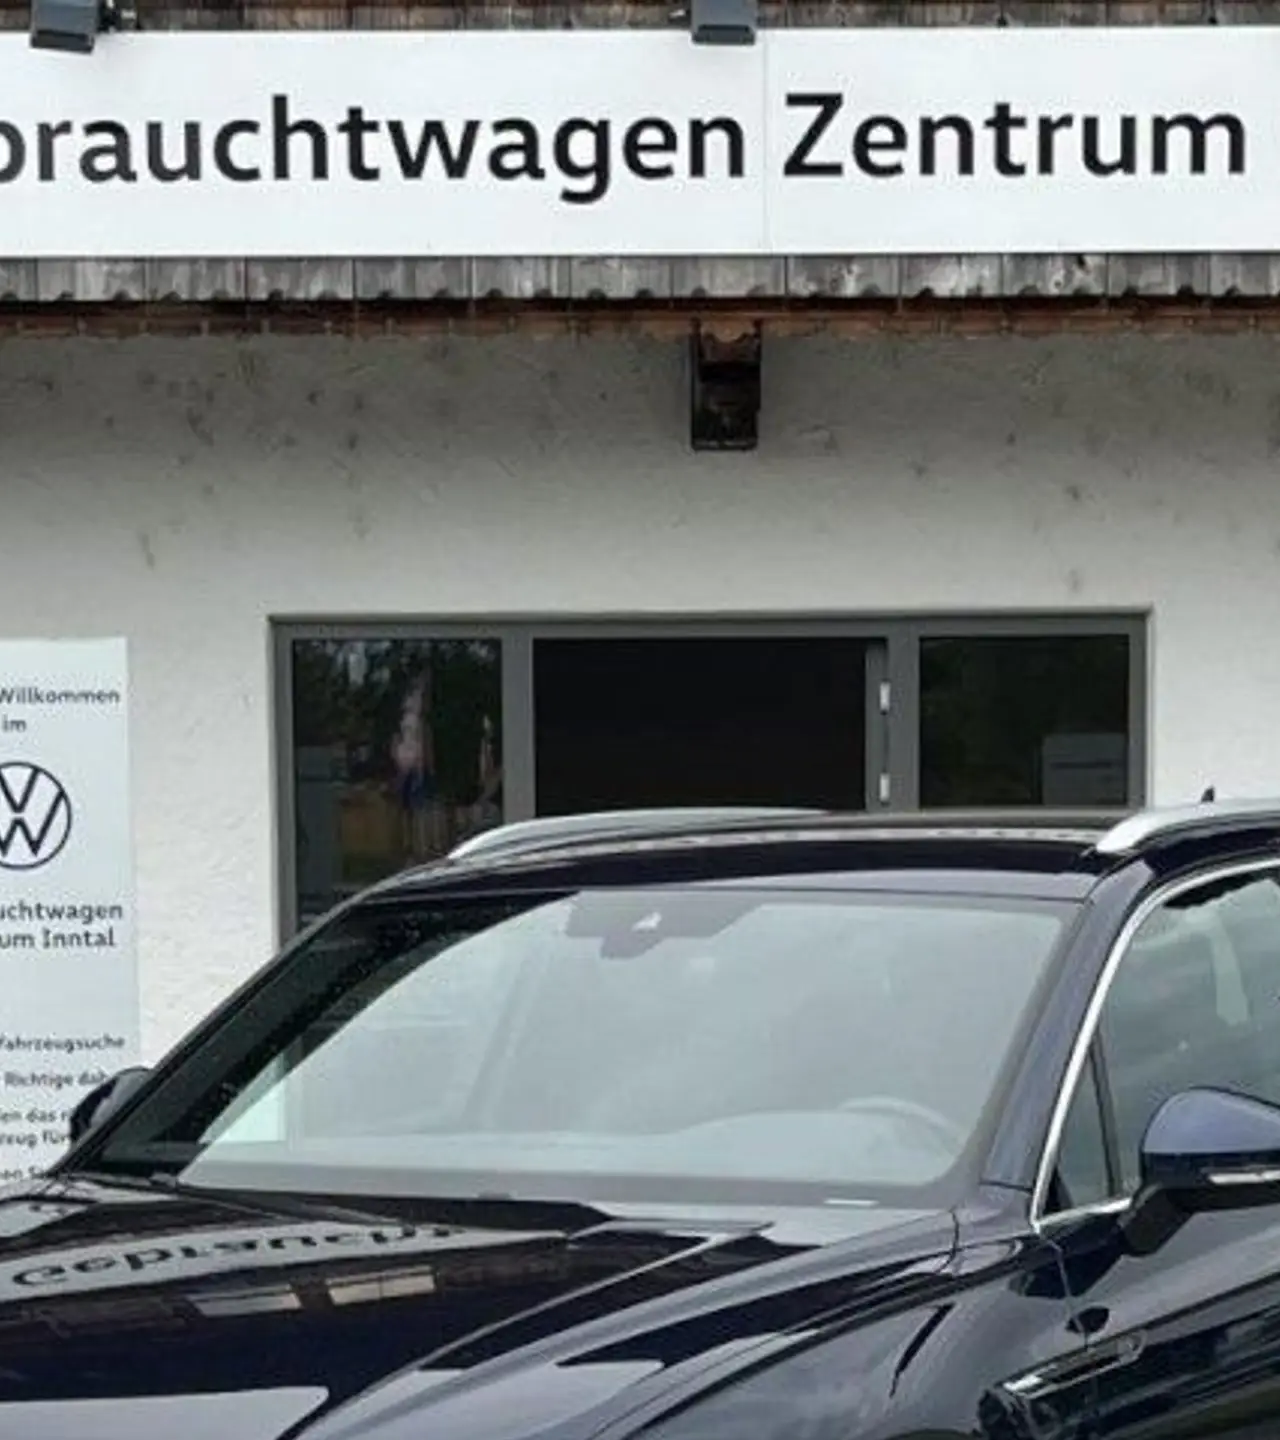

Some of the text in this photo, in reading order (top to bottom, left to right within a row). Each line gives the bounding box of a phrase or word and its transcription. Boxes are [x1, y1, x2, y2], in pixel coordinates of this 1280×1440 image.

[783, 92, 1246, 177] Zentrum
[2, 714, 27, 733] im
[41, 926, 116, 949] Inntal
[26, 1106, 57, 1123] das
